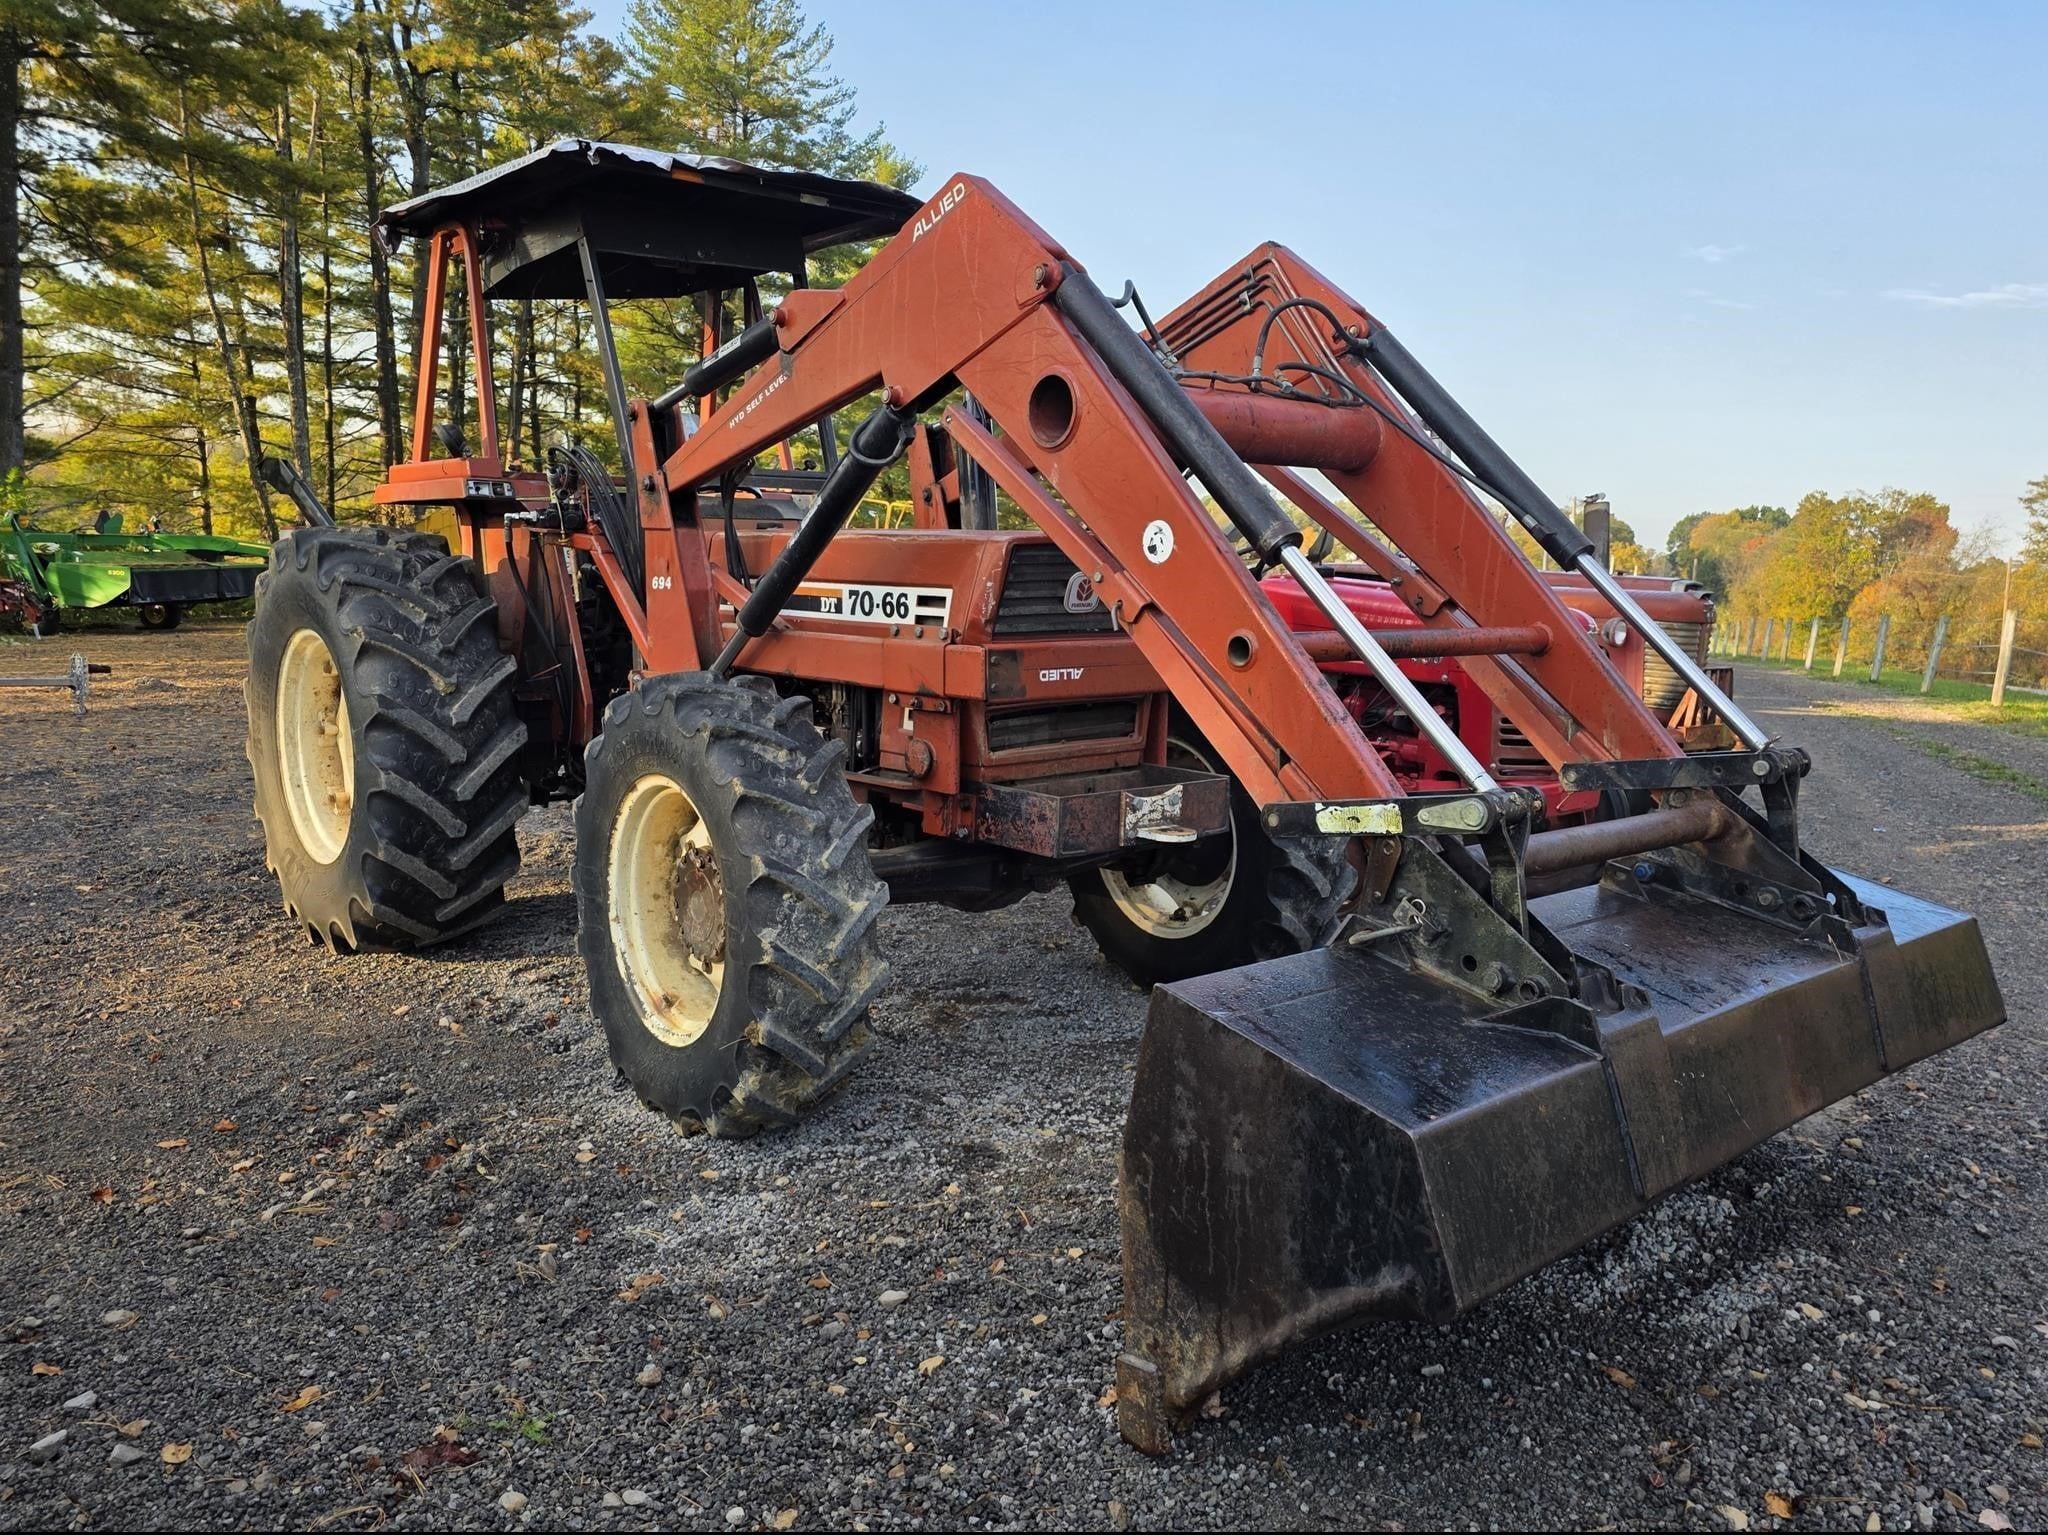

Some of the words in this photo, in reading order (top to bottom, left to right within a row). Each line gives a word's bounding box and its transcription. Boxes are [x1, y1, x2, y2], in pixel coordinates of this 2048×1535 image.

[912, 182, 965, 242] ALLIED
[729, 411, 745, 429] HYD
[745, 393, 764, 414] SELF
[651, 575, 672, 590] 694
[820, 596, 838, 613] DT
[1039, 667, 1084, 682] ALLIED
